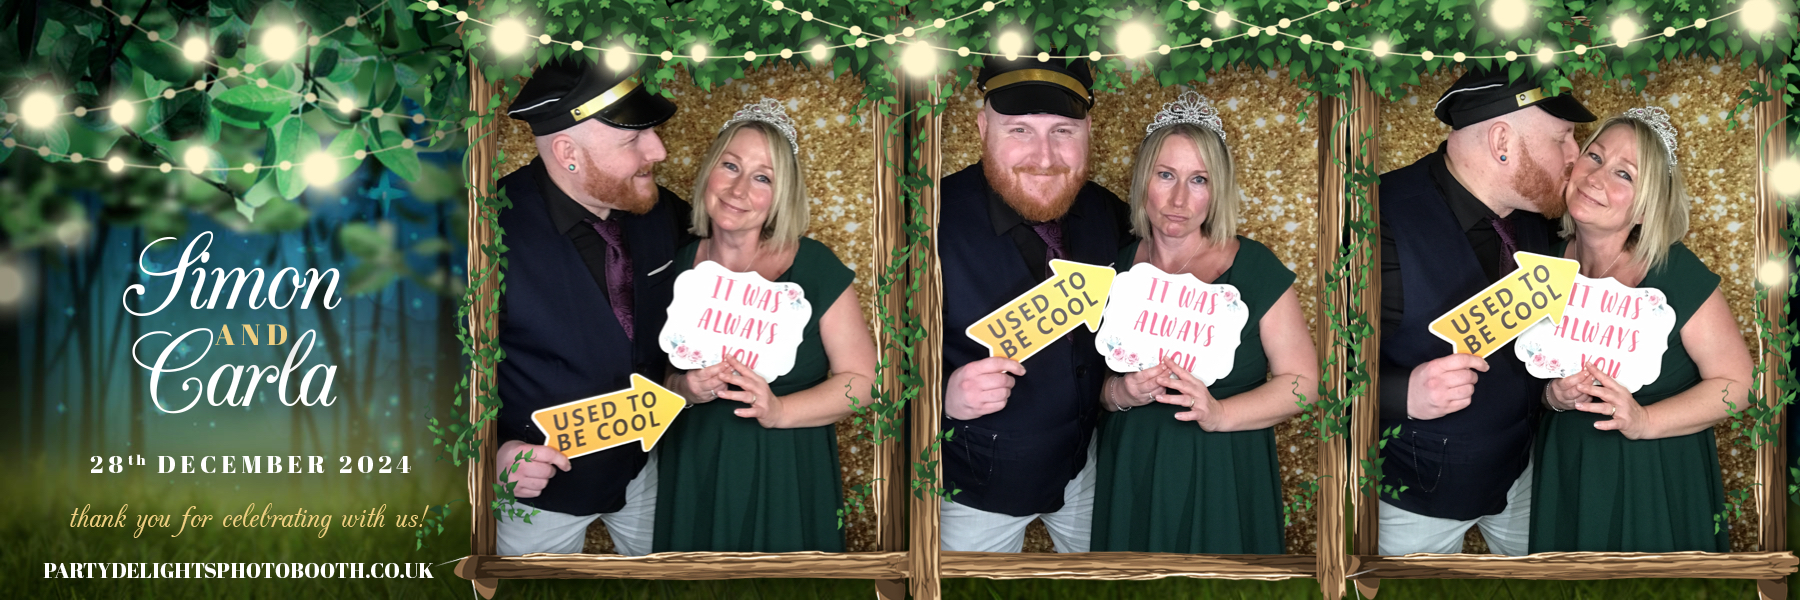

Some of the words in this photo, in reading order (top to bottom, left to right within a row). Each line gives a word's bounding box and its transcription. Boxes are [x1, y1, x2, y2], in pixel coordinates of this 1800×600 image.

[711, 275, 738, 300] IT
[742, 283, 783, 313] WAS
[987, 294, 1050, 339] USED
[1053, 271, 1086, 298] TO
[1146, 277, 1172, 303] IT
[1178, 285, 1219, 315] WAS
[1450, 287, 1514, 335] USED
[1517, 264, 1550, 291] TO
[1567, 282, 1594, 308] IT
[1600, 289, 1643, 320] WAS
[697, 307, 779, 345] ALWAYS
[1000, 330, 1032, 358] BE
[1037, 291, 1099, 335] COOL
[1133, 310, 1215, 347] ALWAYS
[1463, 325, 1496, 354] BE
[1501, 284, 1563, 330] COOL
[1554, 315, 1640, 352] ALWAYS
[721, 345, 759, 370] YOU
[1157, 347, 1197, 373] YOU
[1580, 353, 1622, 379] YOU
[553, 400, 617, 431] USED
[626, 391, 657, 412] TO
[557, 429, 587, 451] BE
[596, 411, 660, 441] COOL
